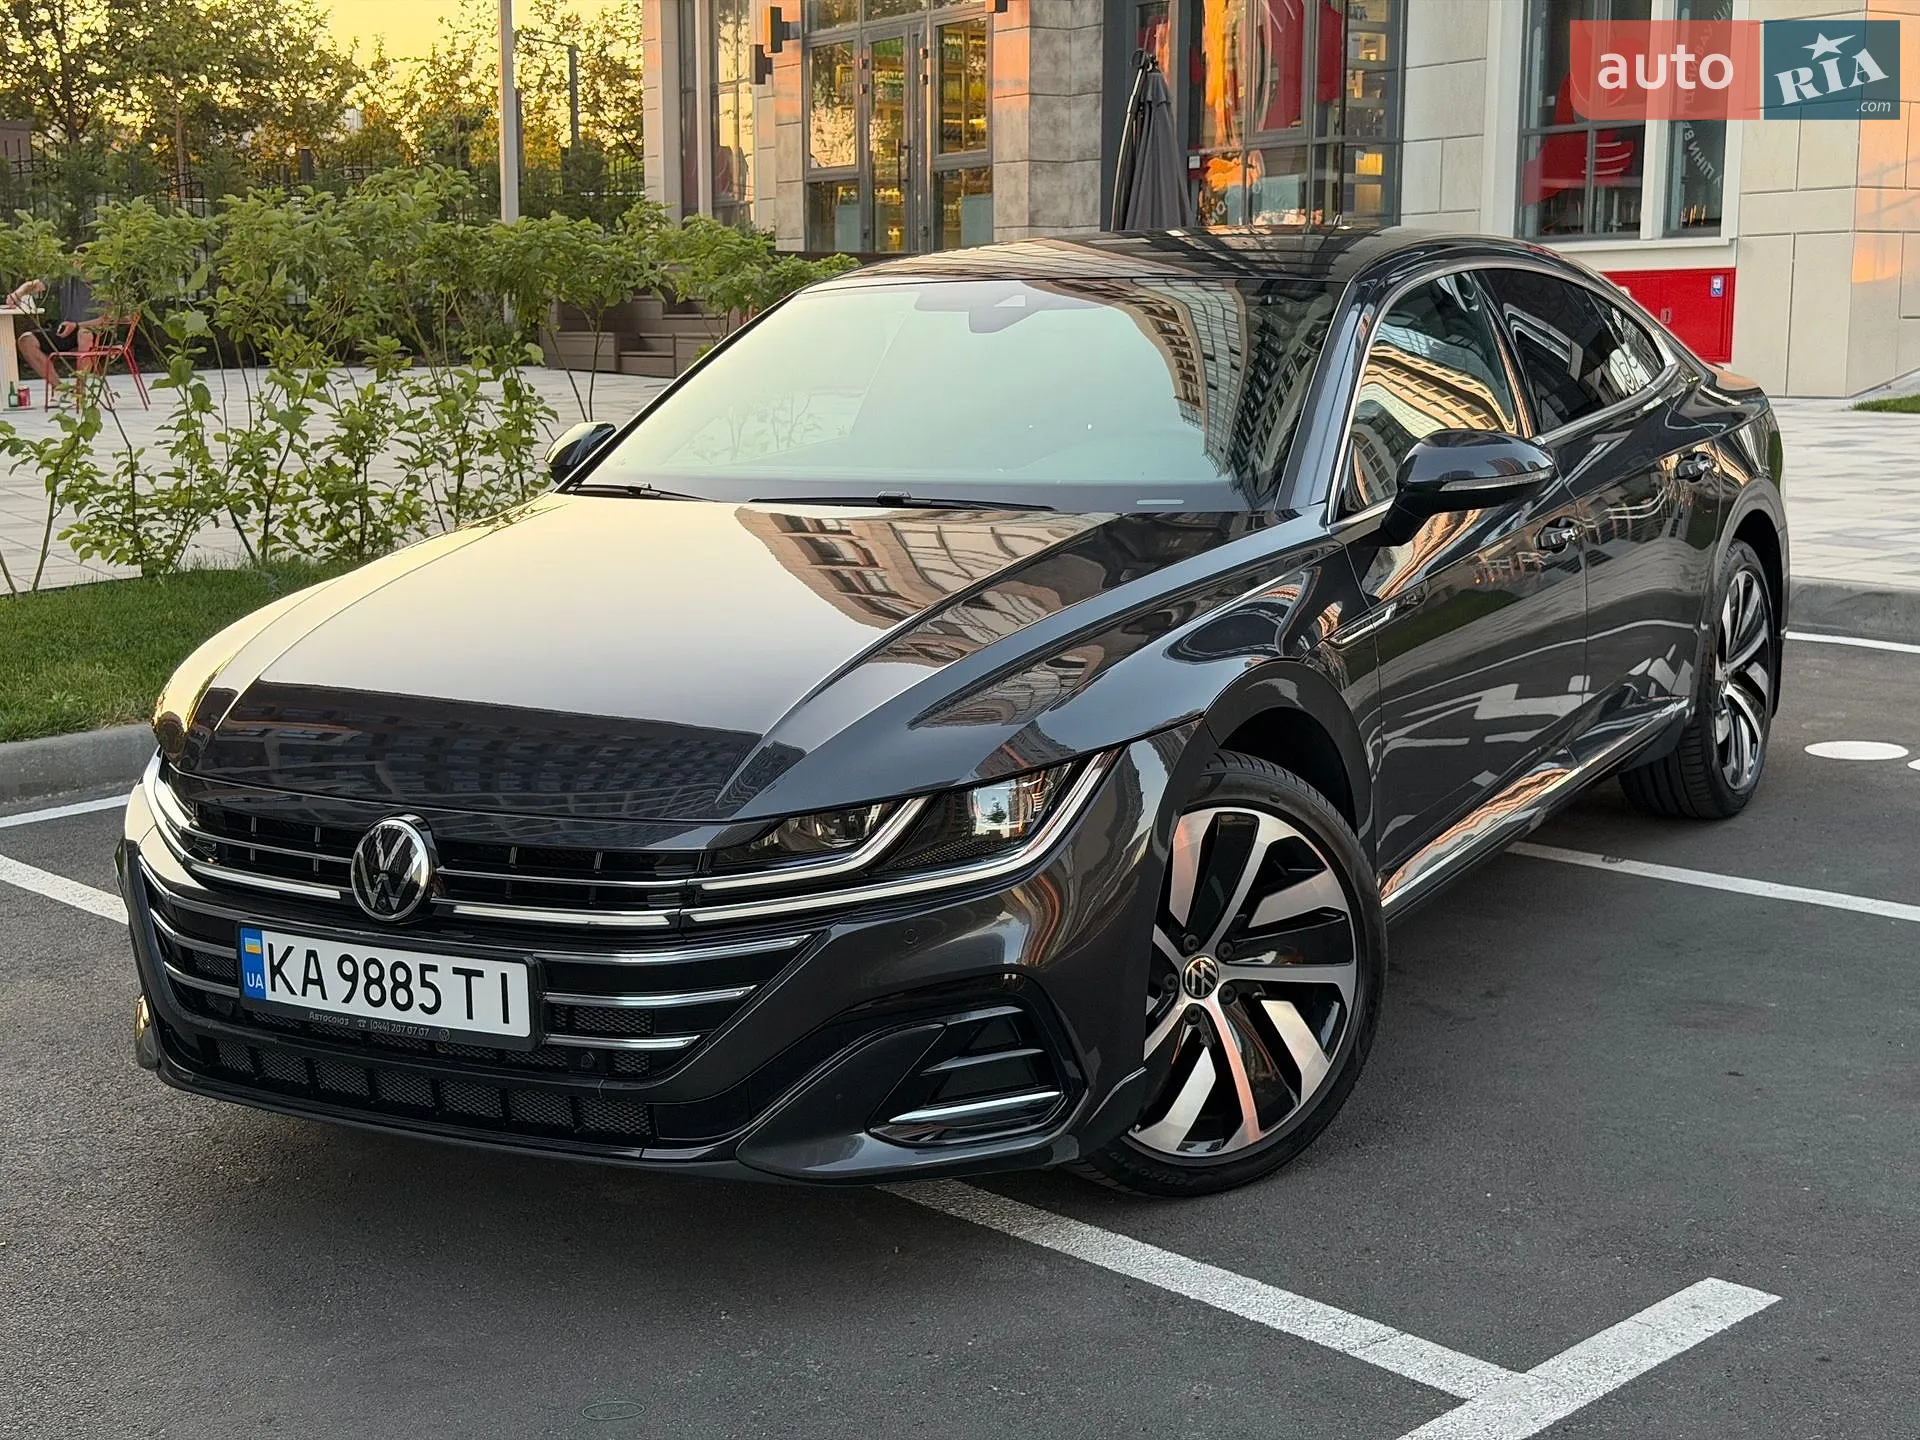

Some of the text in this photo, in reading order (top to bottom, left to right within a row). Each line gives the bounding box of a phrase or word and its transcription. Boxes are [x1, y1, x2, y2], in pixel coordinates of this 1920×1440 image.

[246, 971, 264, 990] UA
[391, 1024, 405, 1033] 207
[407, 1026, 418, 1035] 07
[419, 1027, 430, 1037] 07
